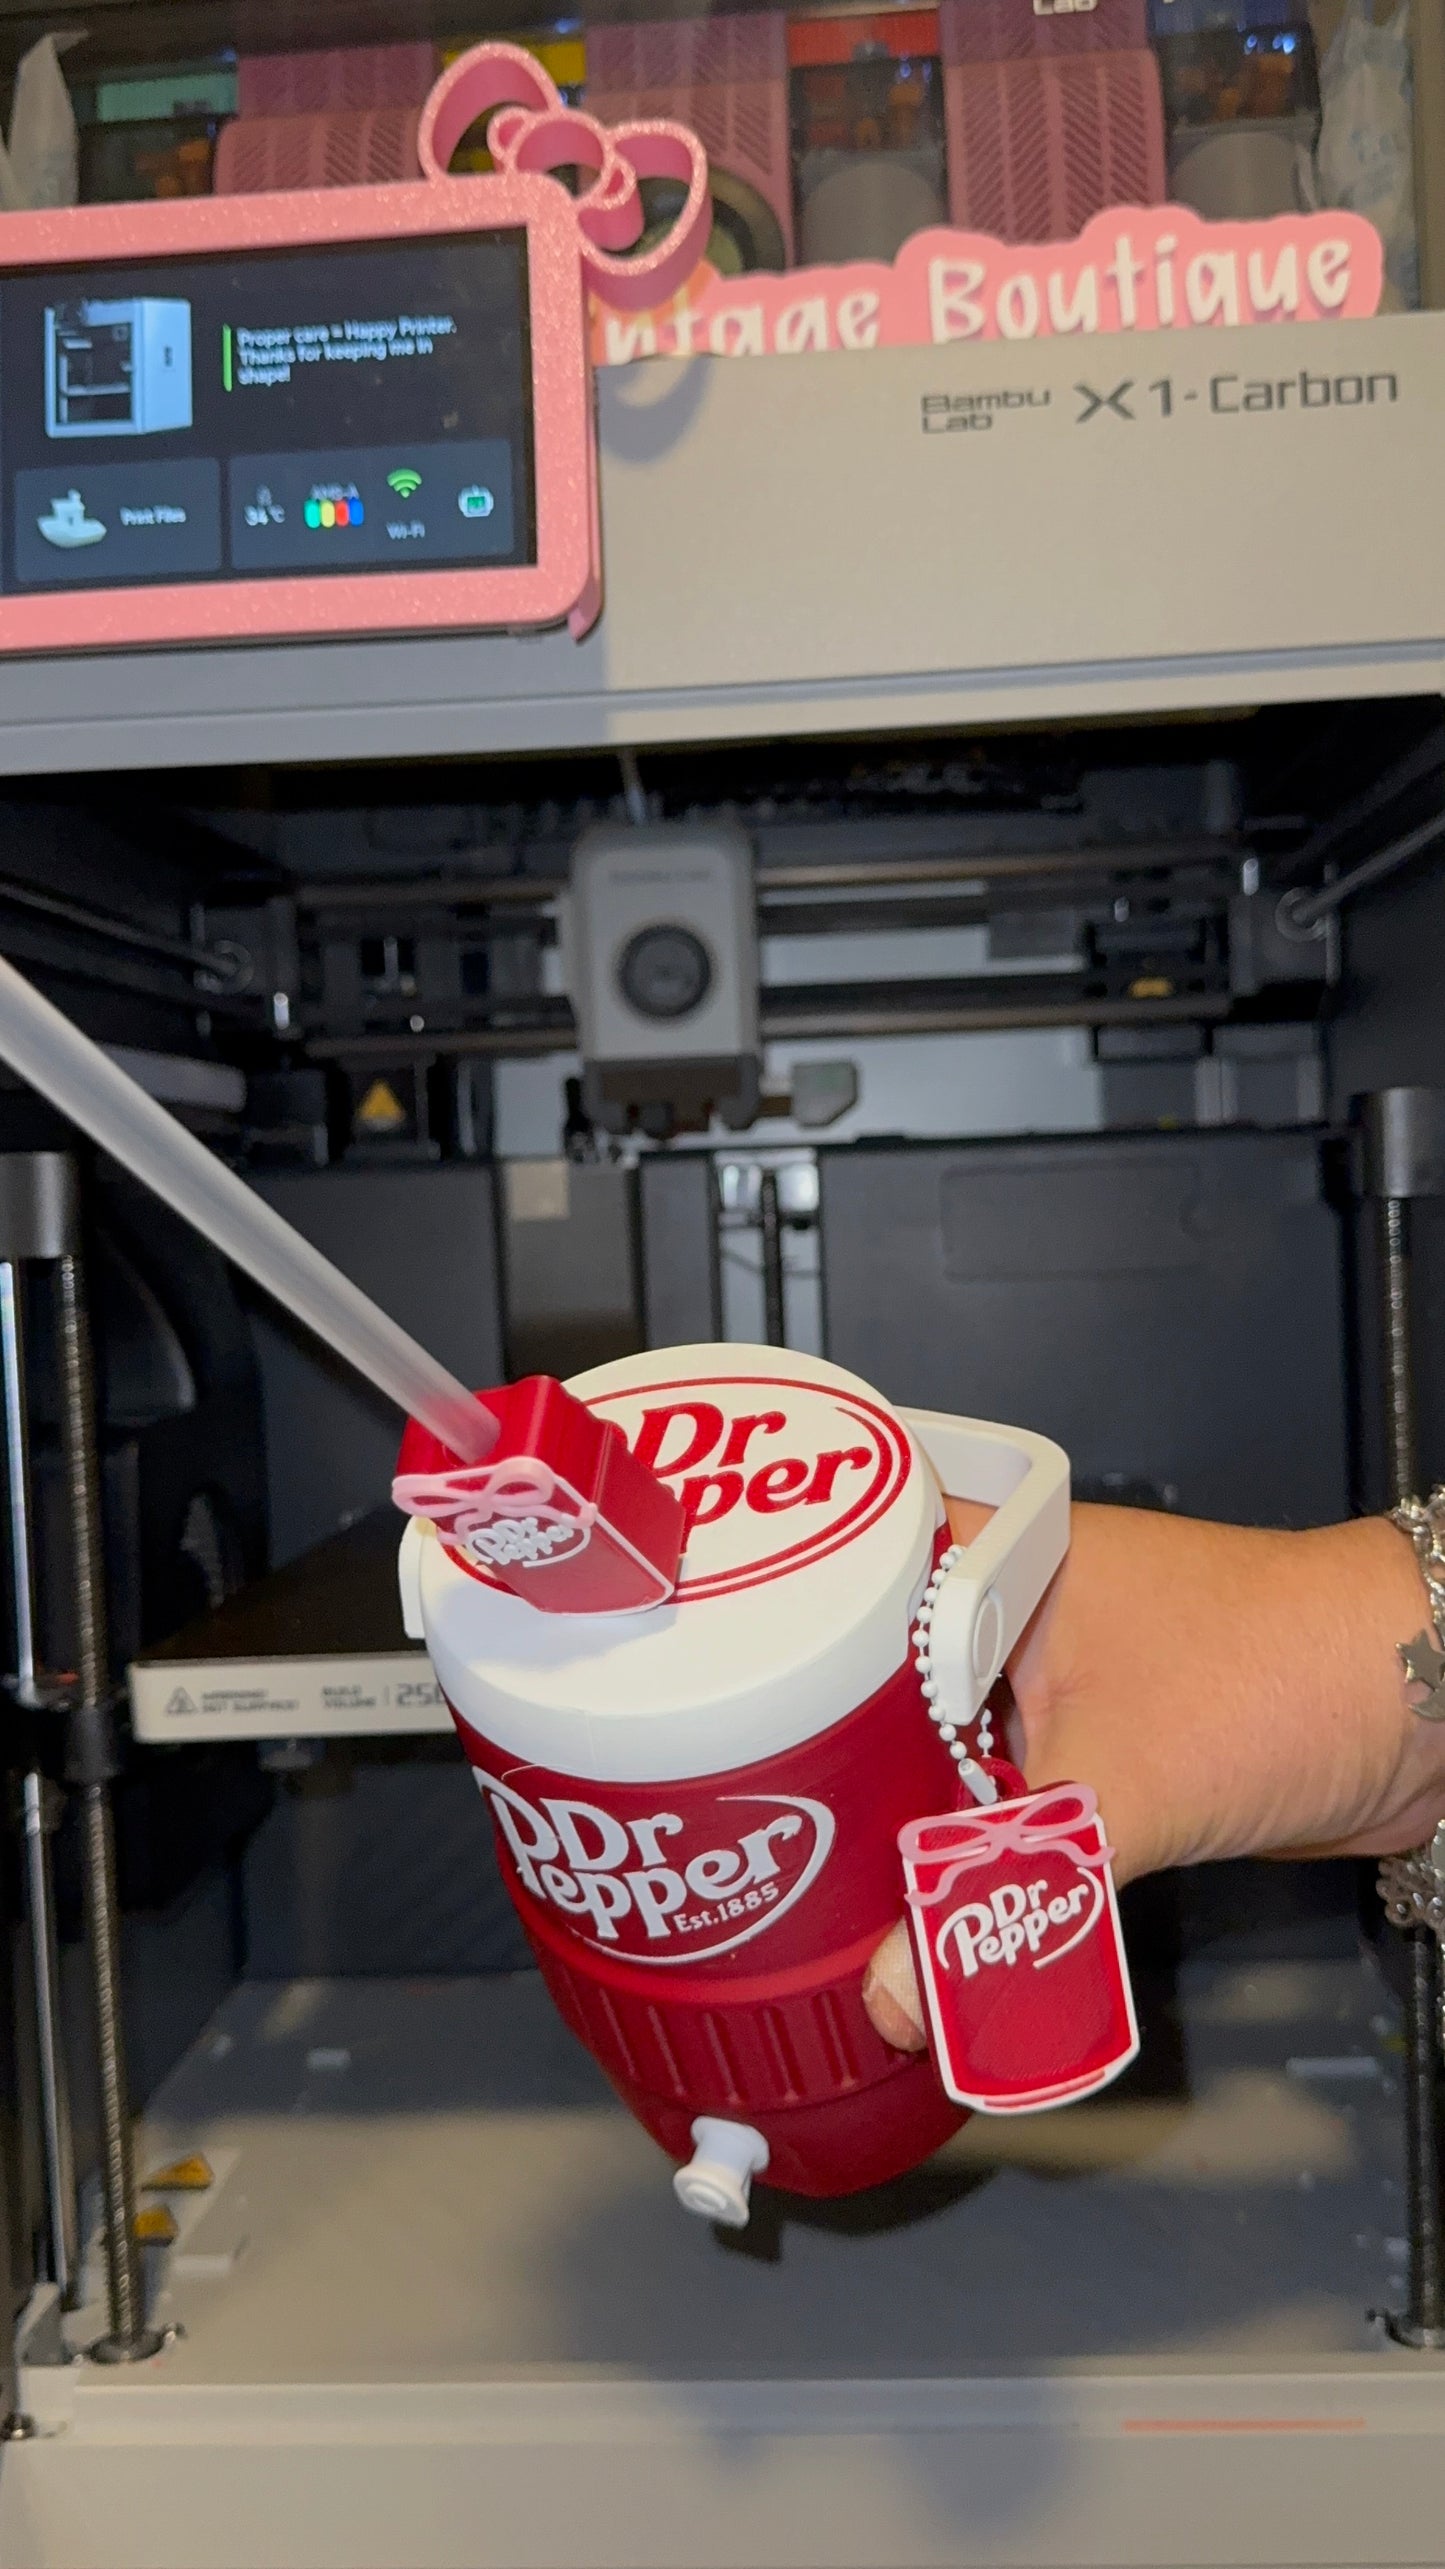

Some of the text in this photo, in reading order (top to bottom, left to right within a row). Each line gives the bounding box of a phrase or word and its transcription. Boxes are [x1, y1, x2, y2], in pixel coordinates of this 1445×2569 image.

[928, 234, 1352, 345] Boutique
[344, 319, 398, 342] Happy
[921, 388, 1051, 416] Bambu
[921, 412, 993, 434] Lab
[634, 1401, 787, 1478] Dr
[676, 1446, 873, 1554] per
[490, 1782, 803, 1940] Pepper
[540, 1798, 684, 1871] Dr
[674, 1881, 779, 1934] Est.1885
[953, 1884, 1090, 1978] Pepper
[990, 1879, 1048, 1929] Dr
